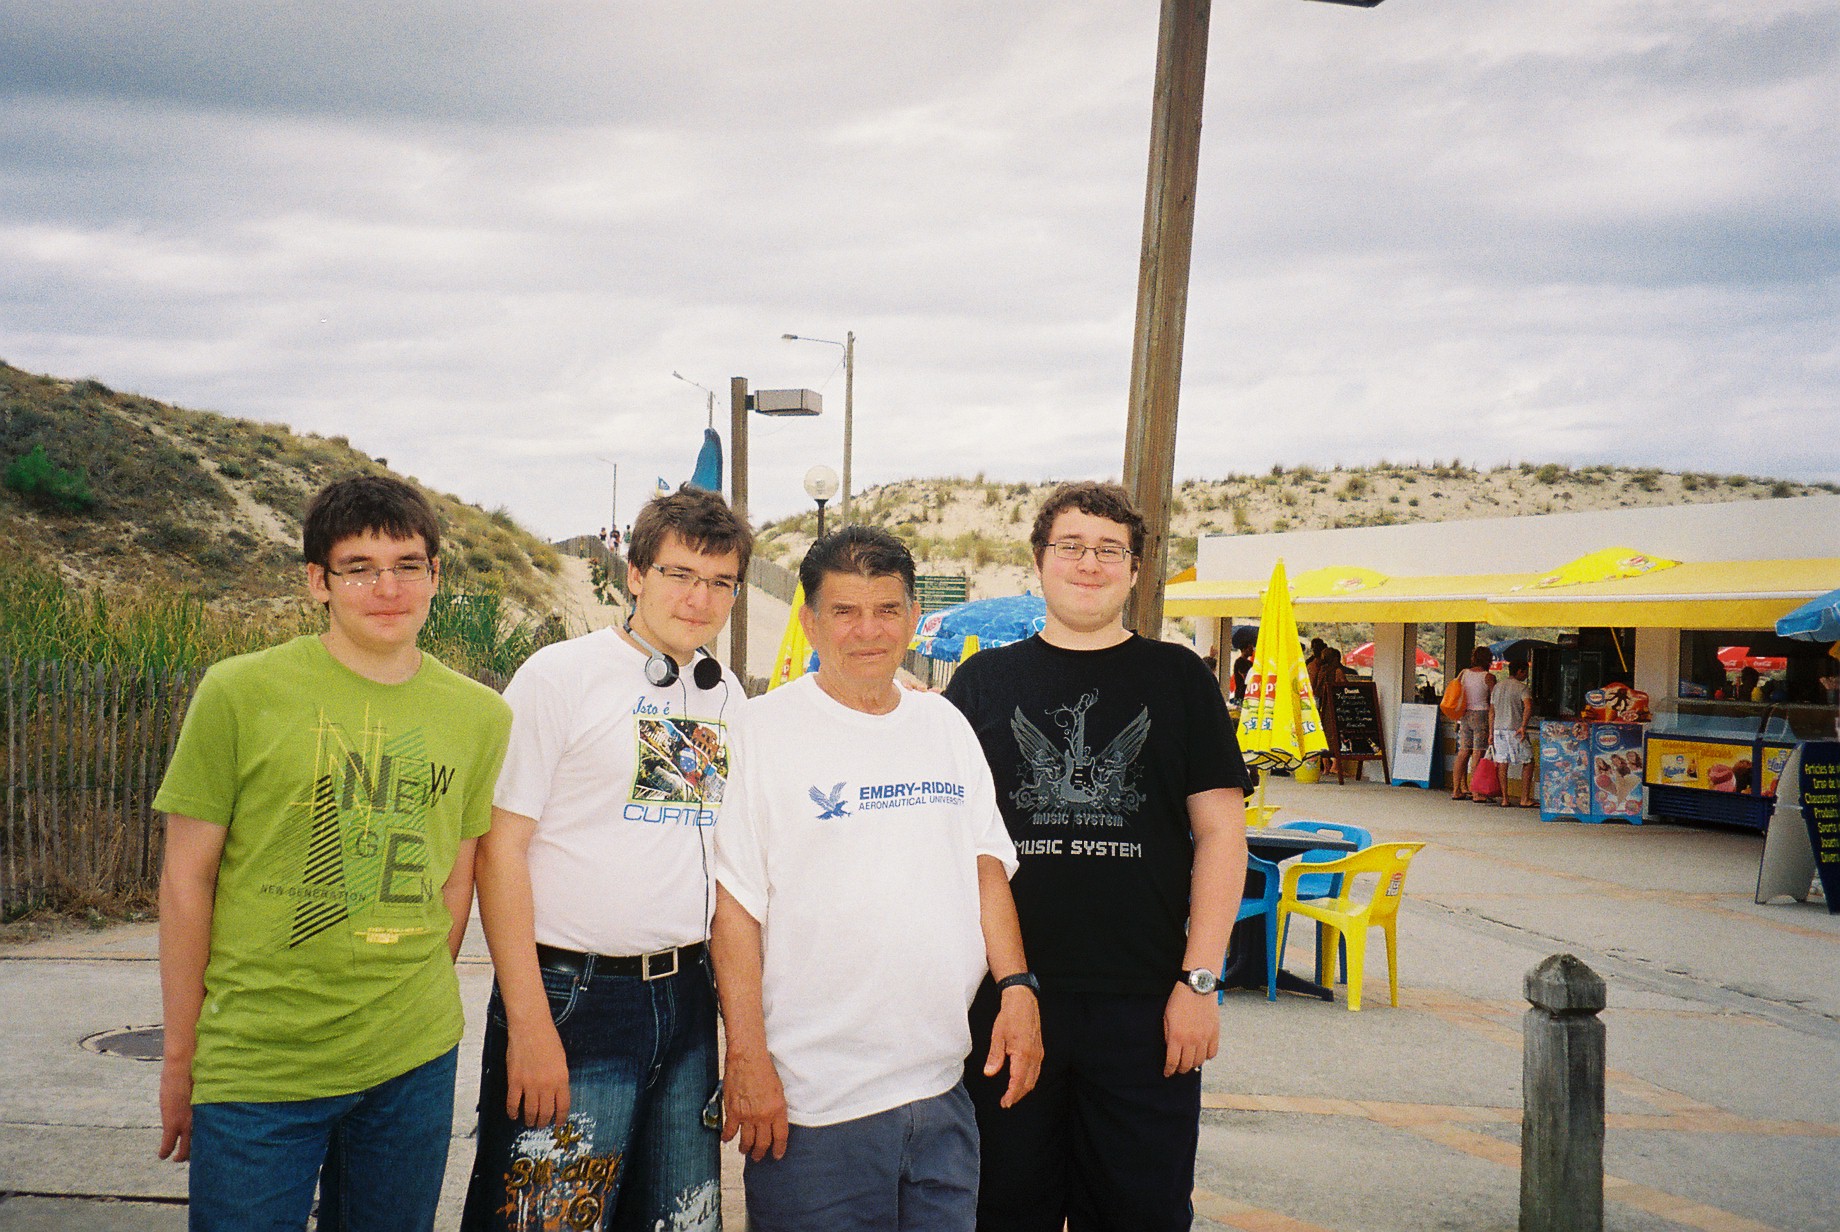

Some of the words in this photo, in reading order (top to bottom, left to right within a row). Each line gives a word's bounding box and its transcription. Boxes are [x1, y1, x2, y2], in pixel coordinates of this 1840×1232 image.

[859, 781, 965, 801] EMBRY-RIDDLE
[858, 798, 926, 811] AERONAUTICAL
[929, 795, 965, 806] UNIVERSITY
[1014, 839, 1063, 856] MUSIC
[1070, 840, 1142, 859] SYSTEM
[260, 884, 284, 897] NEW
[287, 887, 367, 902] GENERATION
